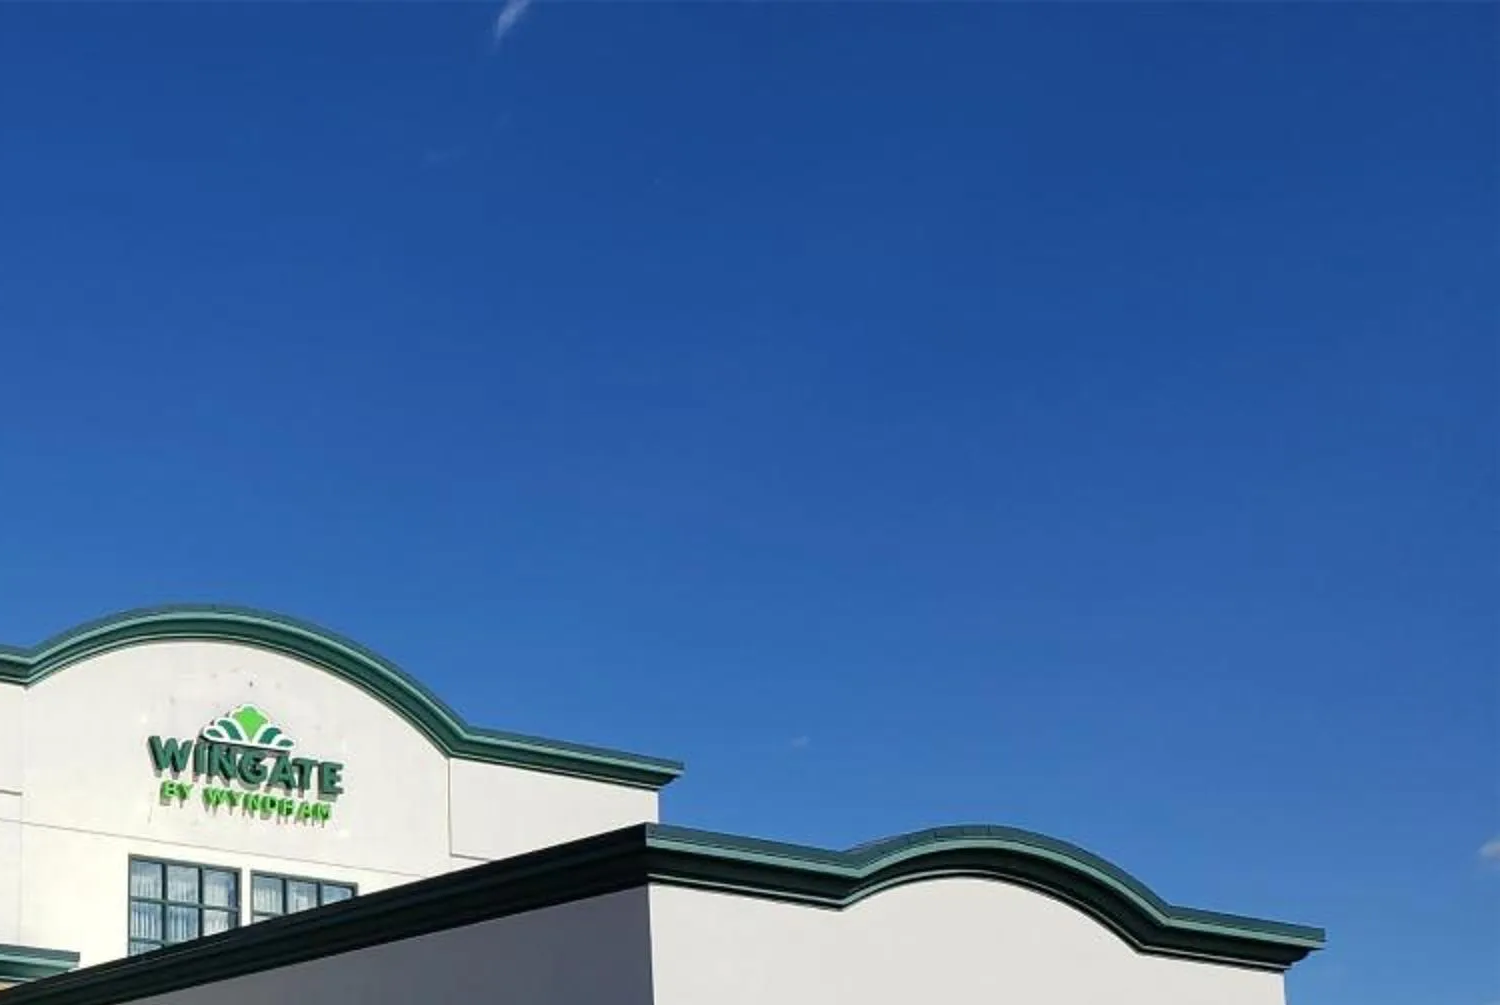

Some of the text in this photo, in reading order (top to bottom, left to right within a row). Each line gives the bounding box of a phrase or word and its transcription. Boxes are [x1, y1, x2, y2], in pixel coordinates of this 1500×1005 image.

[148, 735, 344, 795] WINGATE
[160, 780, 331, 821] BY WYNDHAM
